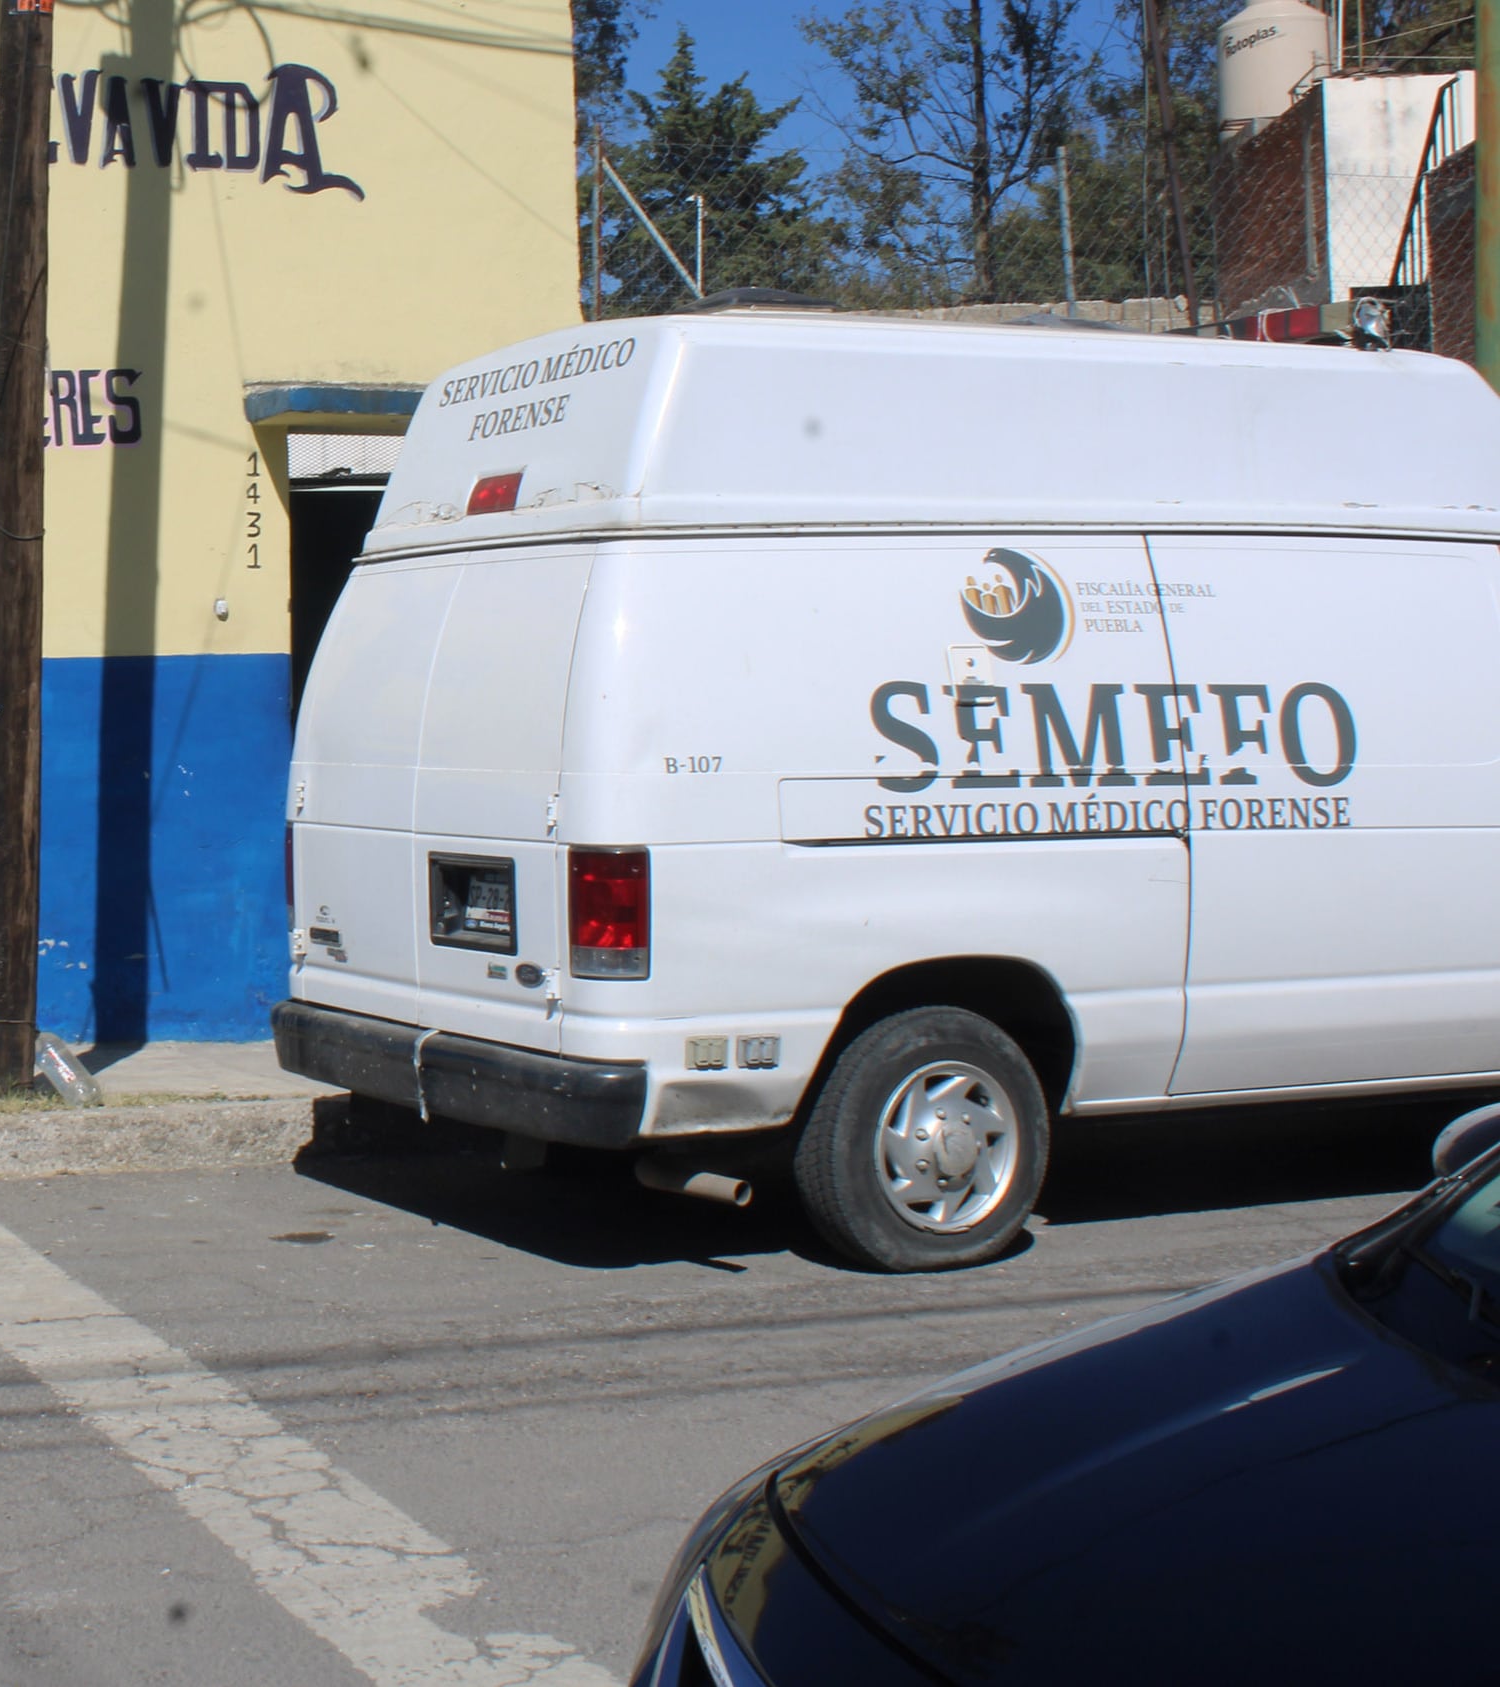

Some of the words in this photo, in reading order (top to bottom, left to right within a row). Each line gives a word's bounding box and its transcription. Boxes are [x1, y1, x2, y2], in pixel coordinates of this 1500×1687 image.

[439, 360, 539, 408] SERVICIO
[538, 337, 636, 385] MÉDICO
[467, 394, 571, 441] FORENSE
[1076, 580, 1144, 596] FISCALÍA
[1146, 583, 1216, 597] GENERAL
[1081, 602, 1102, 612] DEL
[1107, 601, 1163, 614] ESTADO
[1169, 603, 1184, 613] DE
[1084, 619, 1143, 632] PUEBLA
[870, 681, 1357, 793] SEMEFO
[664, 756, 722, 774] B-107
[864, 803, 1038, 838] SERVICIO
[1049, 793, 1191, 834] MÉDICO
[1200, 796, 1352, 829] FORENSE
